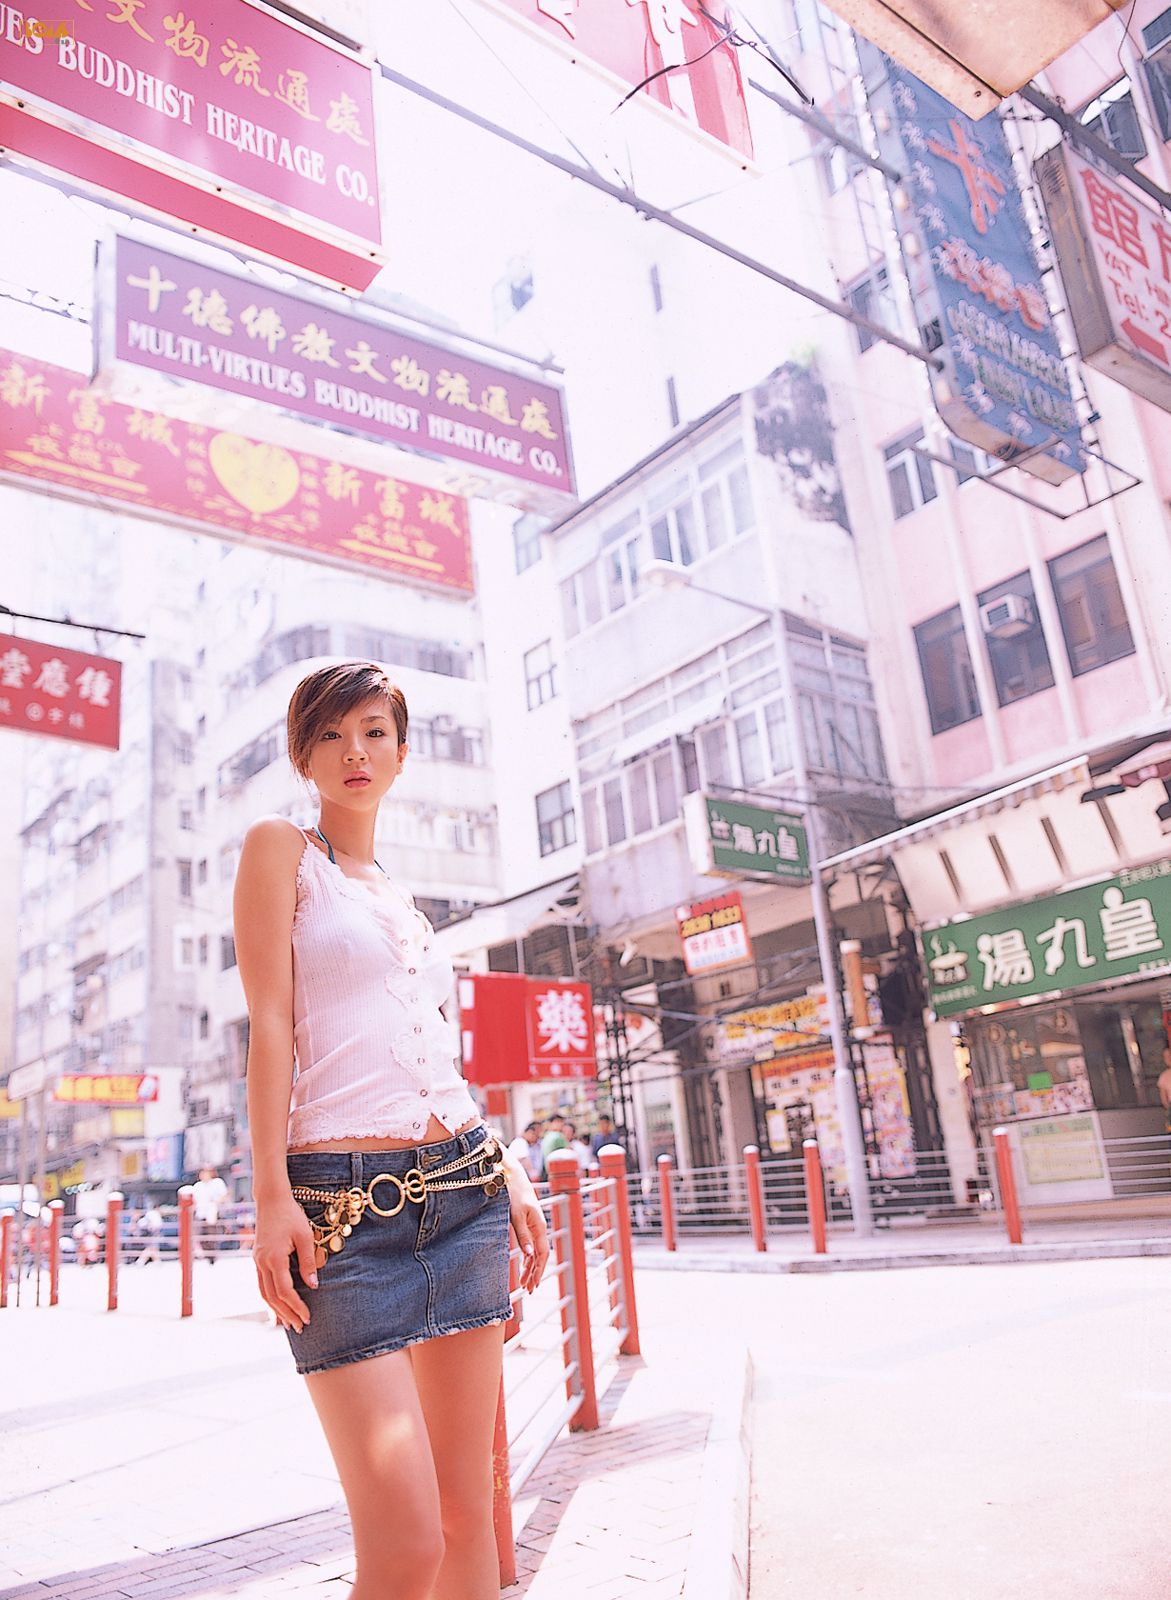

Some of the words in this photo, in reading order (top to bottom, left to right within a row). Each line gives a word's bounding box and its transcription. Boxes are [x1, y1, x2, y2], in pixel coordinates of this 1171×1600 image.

[58, 36, 195, 126] BUDDHIST
[206, 103, 326, 185] HERITAGE
[335, 165, 375, 207] CO.
[127, 320, 306, 400] MULTI-VIRTUES
[315, 378, 421, 433] BUDDHIST
[428, 413, 524, 466] HERITAGE
[530, 445, 563, 478] CO.
[976, 885, 1164, 991] 湯丸皇
